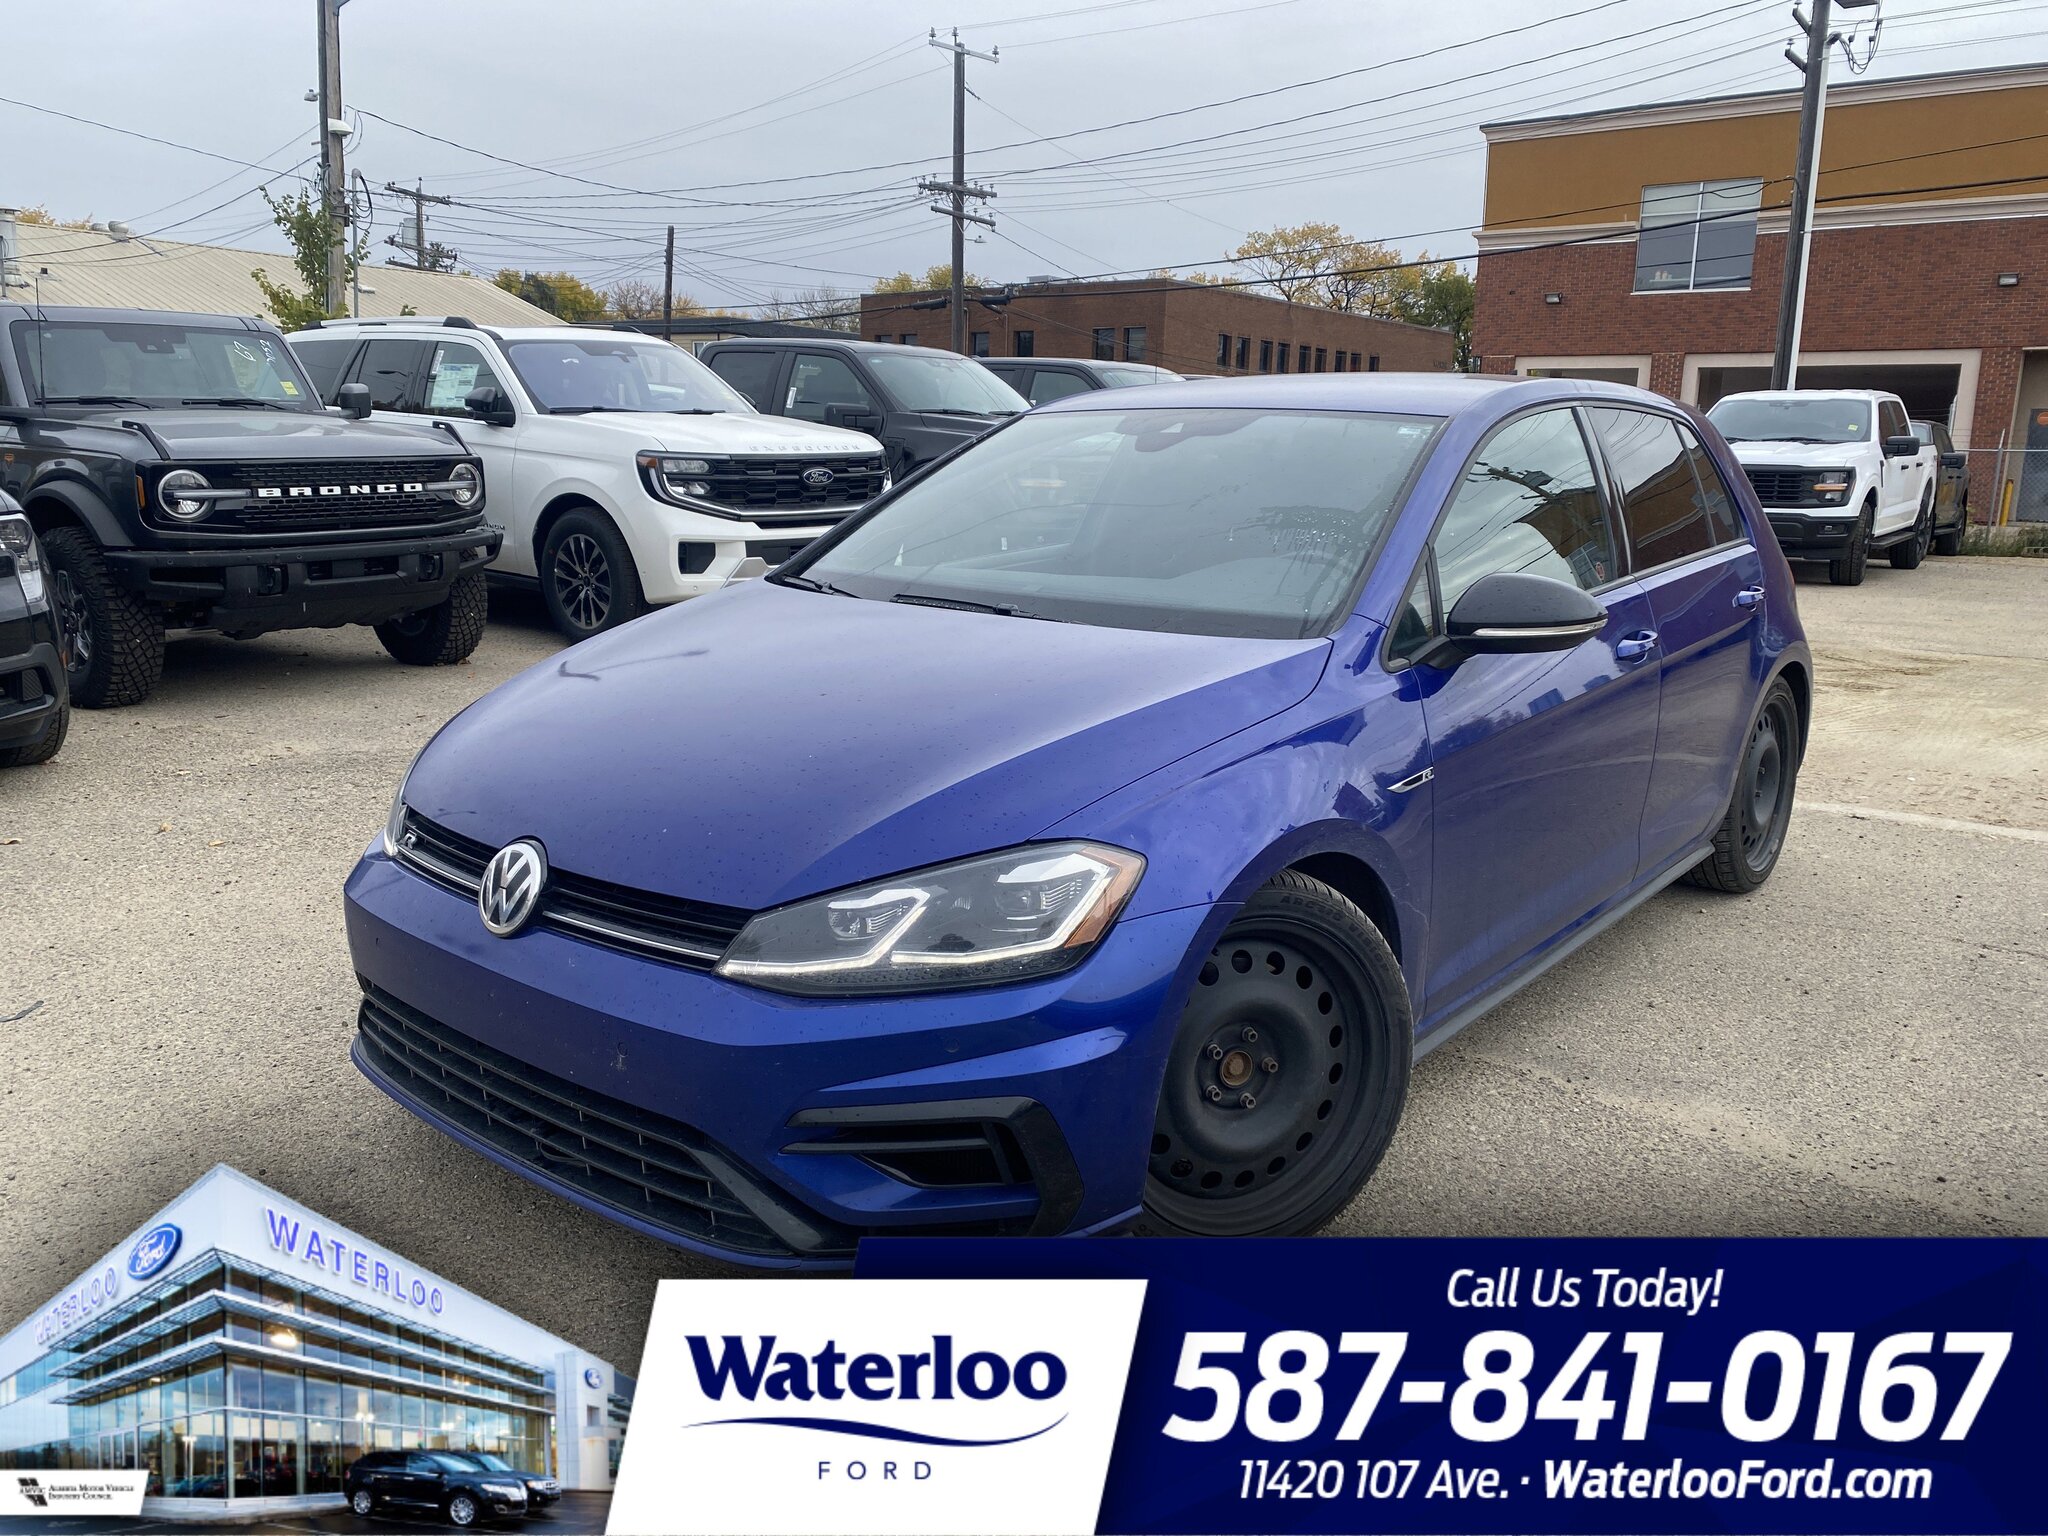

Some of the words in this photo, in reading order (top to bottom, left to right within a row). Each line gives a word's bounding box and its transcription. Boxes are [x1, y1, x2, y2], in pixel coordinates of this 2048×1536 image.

[749, 444, 860, 452] EXPEDITION
[807, 470, 831, 483] Ford
[257, 482, 423, 498] BRONCO
